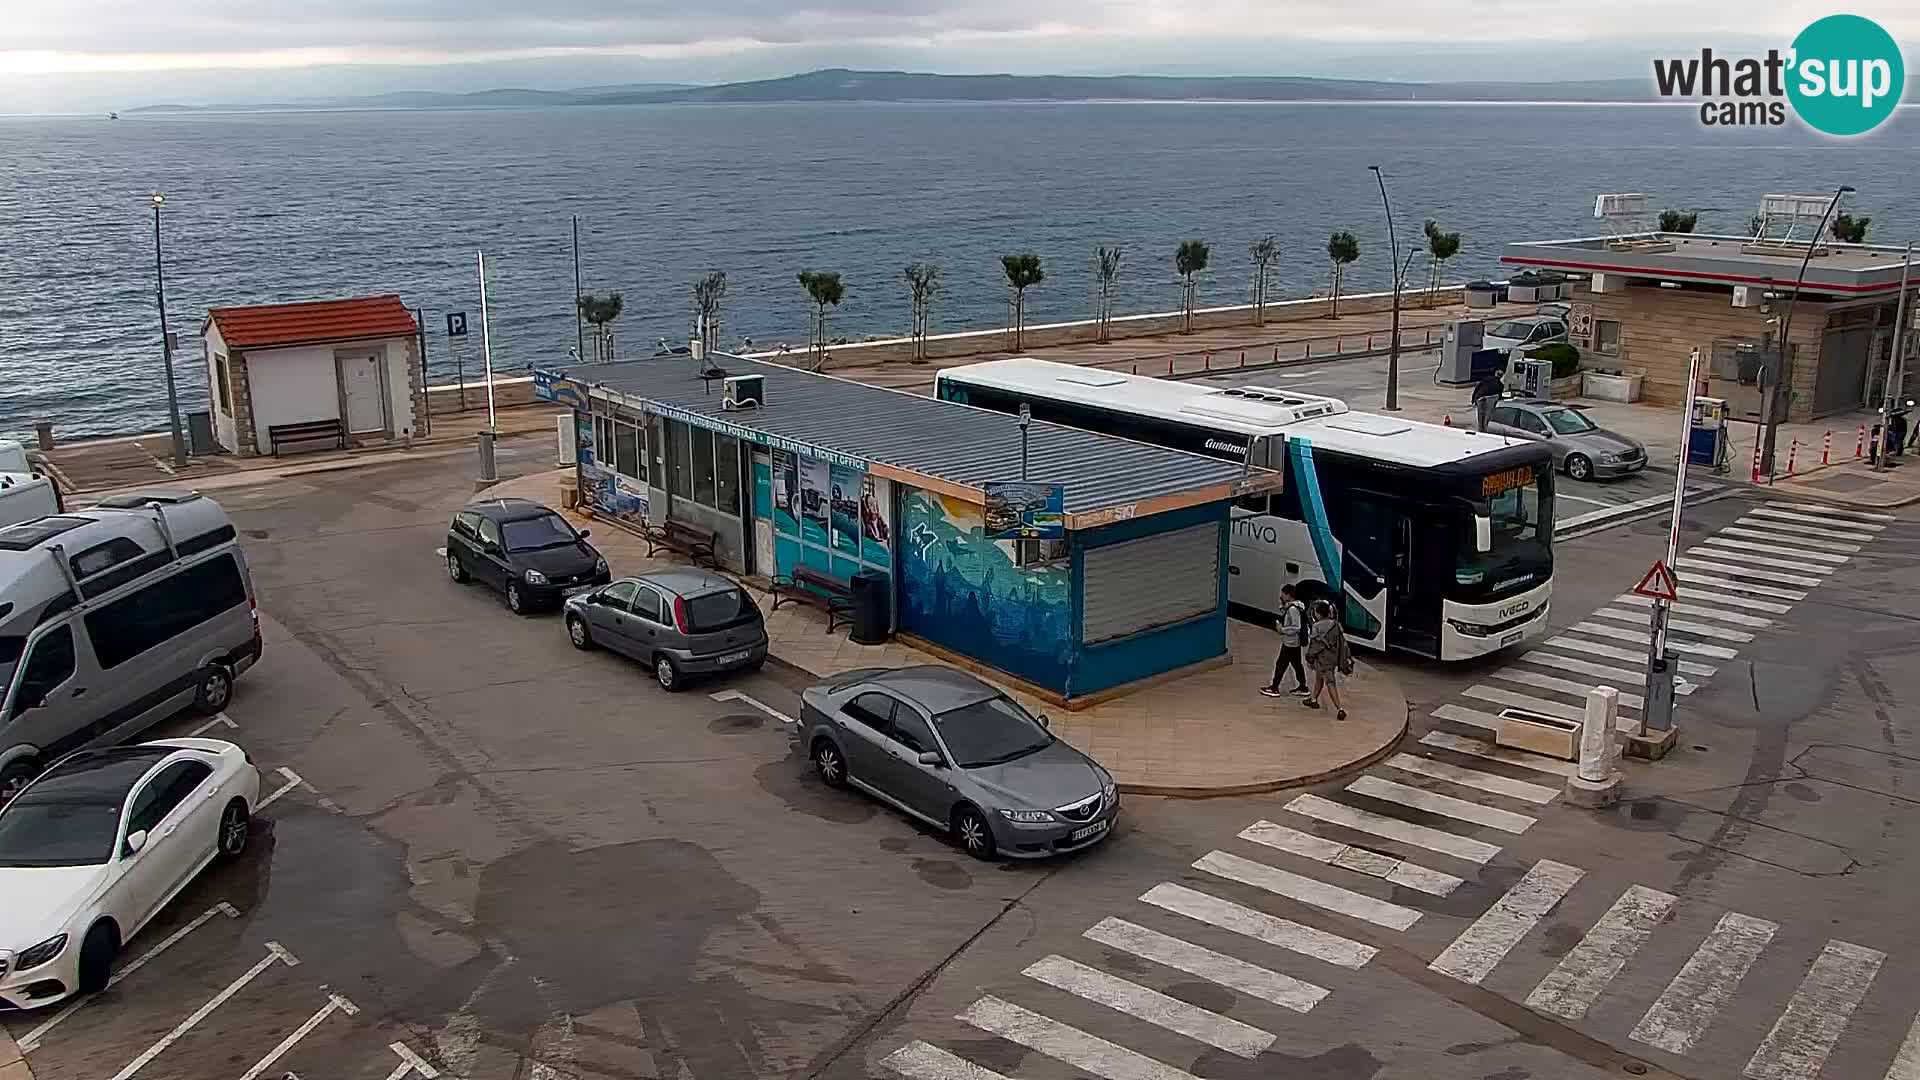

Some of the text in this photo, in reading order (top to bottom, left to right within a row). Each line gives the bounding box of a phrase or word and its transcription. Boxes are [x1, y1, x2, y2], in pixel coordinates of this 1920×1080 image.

[451, 315, 463, 334] P
[690, 414, 728, 433] AUTOBUSNA
[728, 425, 757, 441] POSTAJA
[766, 434, 781, 448] BUS
[781, 439, 812, 457] STATION
[814, 448, 839, 464] TICKET
[839, 455, 865, 471] OFFICE
[1204, 438, 1247, 455] Autotran
[1231, 519, 1277, 544] rriva
[1499, 600, 1529, 619] IVECO
